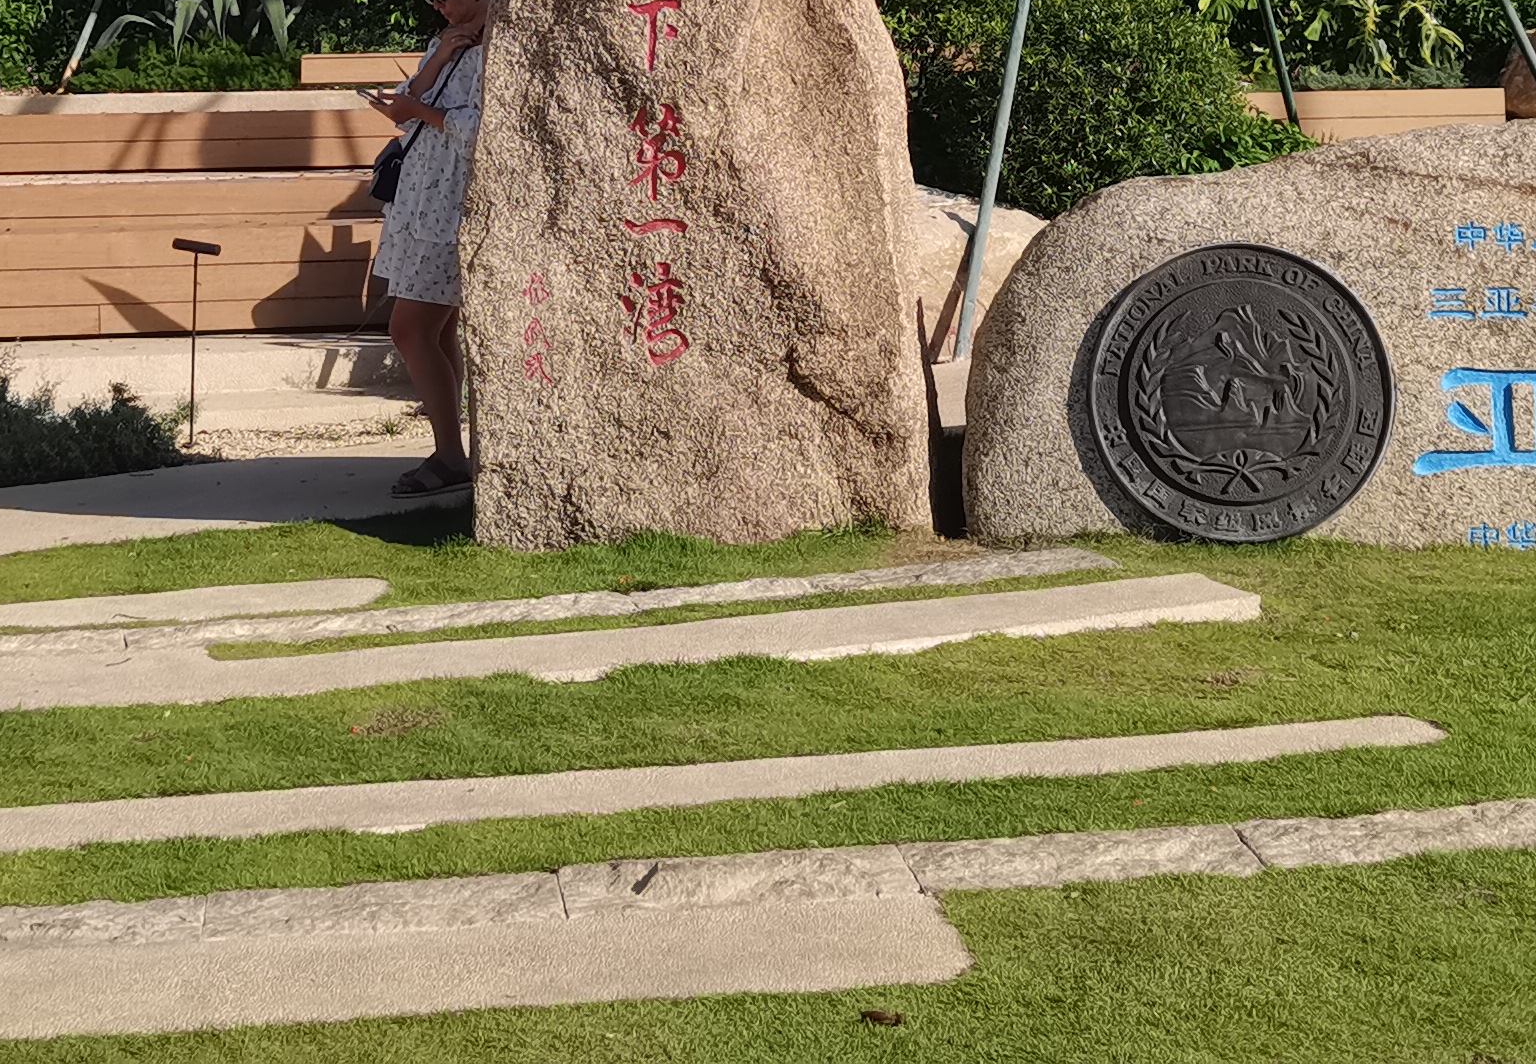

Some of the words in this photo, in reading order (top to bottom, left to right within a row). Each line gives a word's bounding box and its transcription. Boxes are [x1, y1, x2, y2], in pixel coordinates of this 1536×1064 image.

[1103, 270, 1191, 378] NATIONAL
[1201, 254, 1275, 278] PARK
[1282, 267, 1320, 292] OF
[1323, 293, 1375, 371] CHINA
